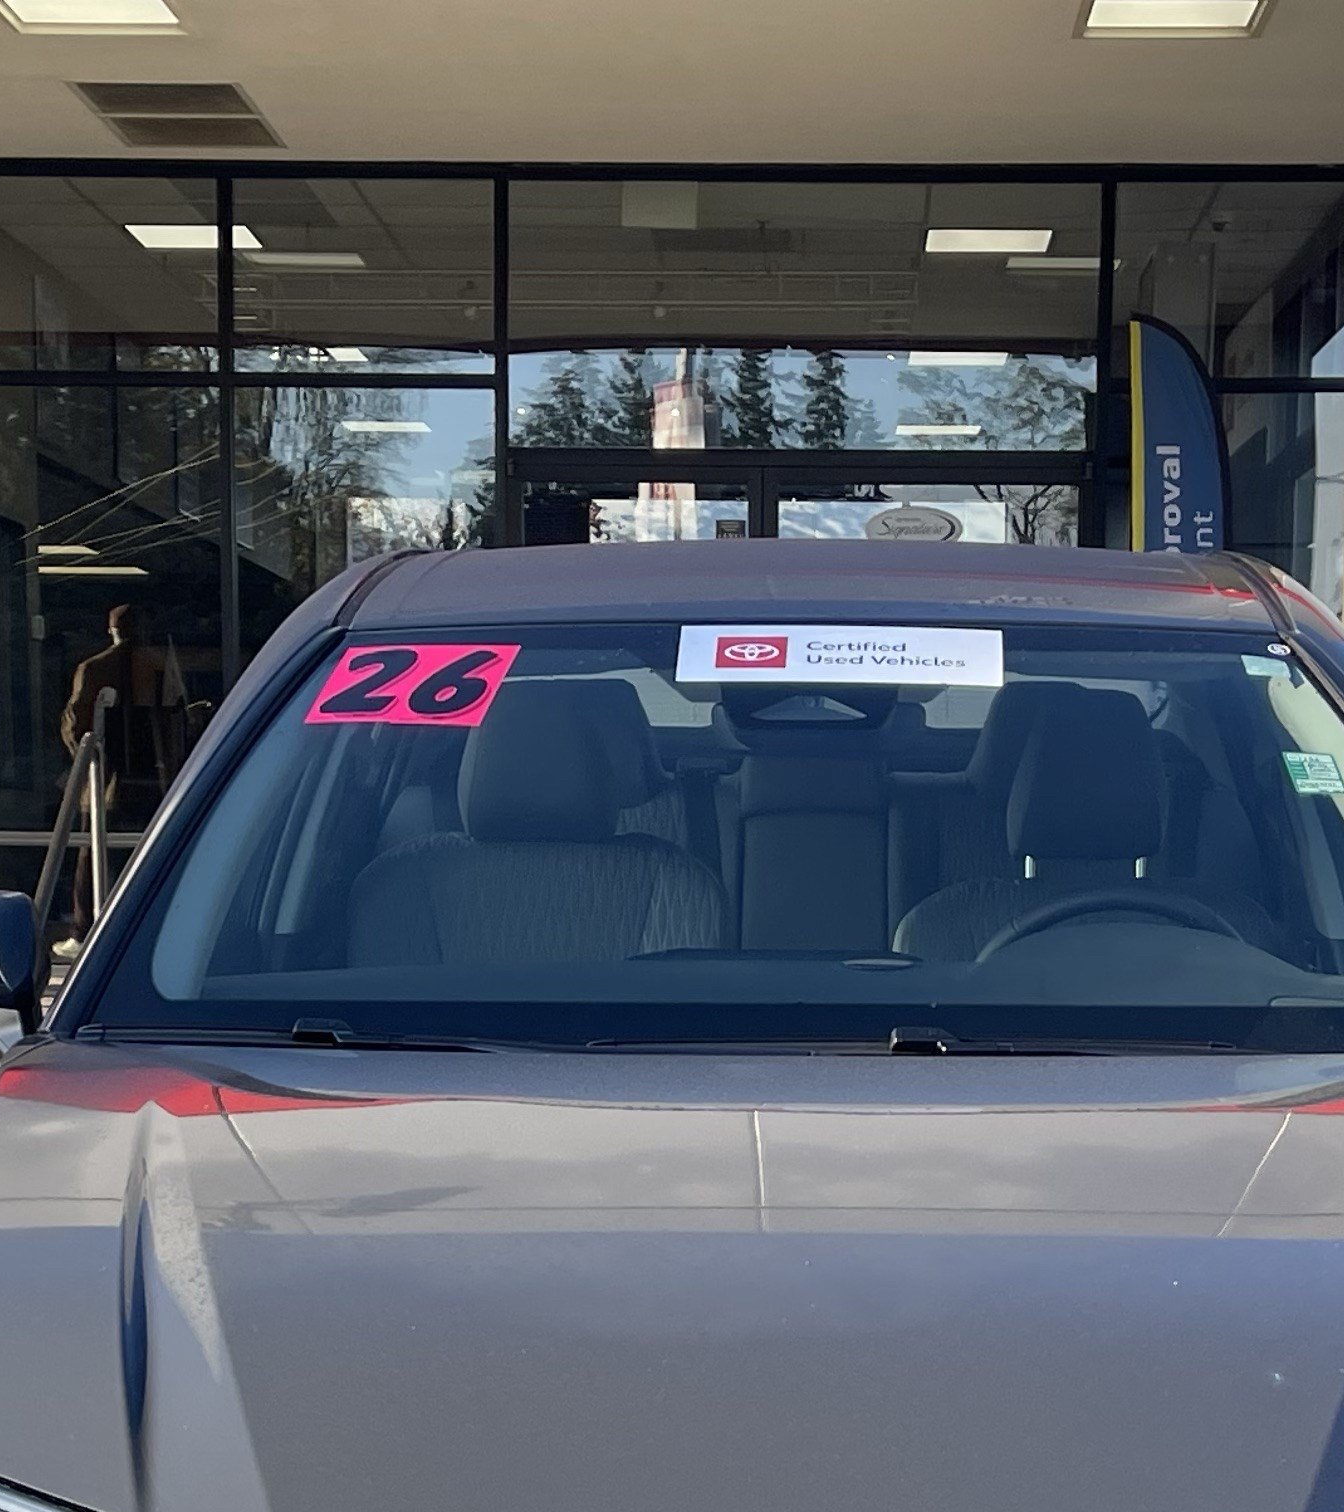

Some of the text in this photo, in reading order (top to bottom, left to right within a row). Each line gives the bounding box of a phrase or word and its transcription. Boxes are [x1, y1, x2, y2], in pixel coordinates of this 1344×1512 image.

[1194, 511, 1214, 552] nt
[806, 639, 907, 653] Certified
[806, 654, 967, 669] Used Vehicles
[319, 649, 498, 717] 26
